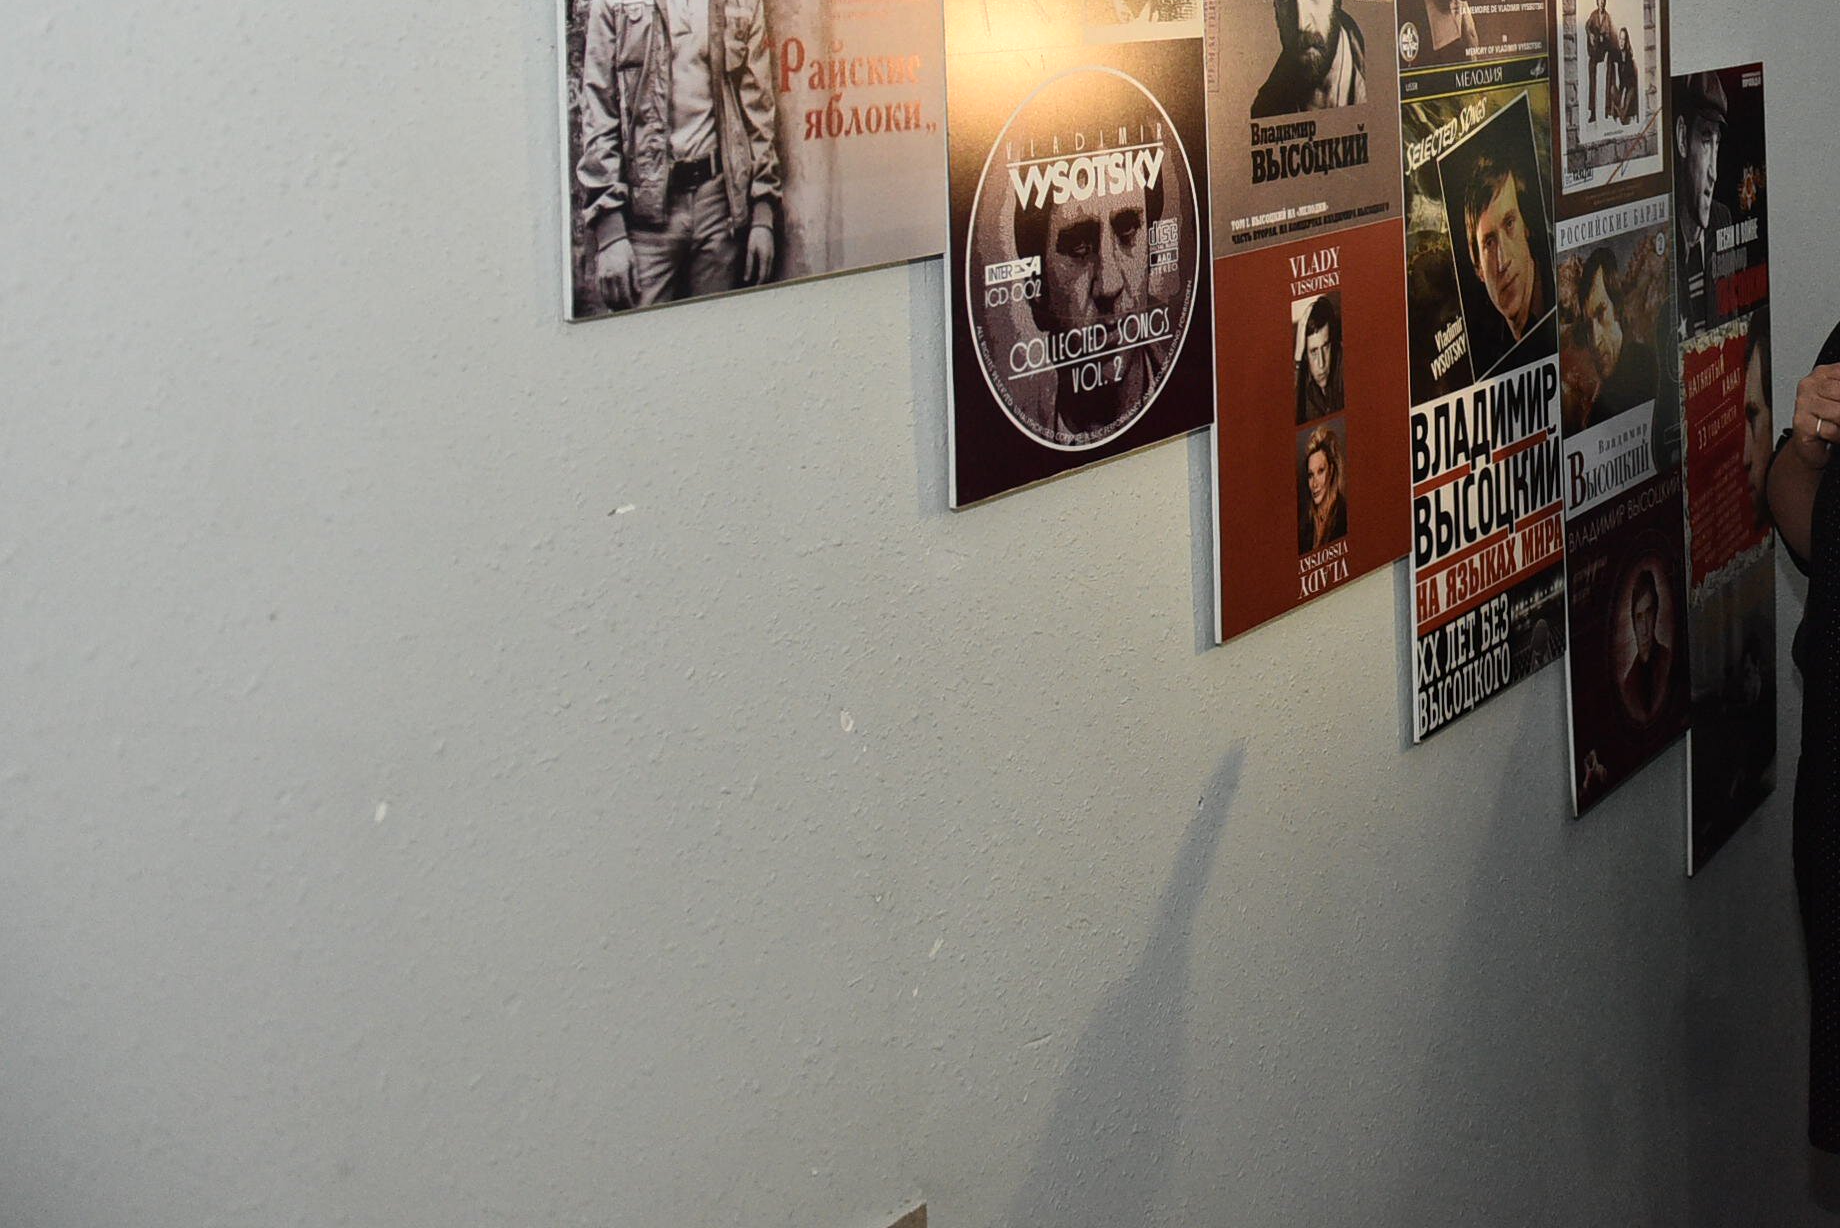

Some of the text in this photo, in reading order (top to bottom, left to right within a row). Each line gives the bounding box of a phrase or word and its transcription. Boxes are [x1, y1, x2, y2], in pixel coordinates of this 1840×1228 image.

[1455, 66, 1504, 89] МЕЛОДИЯ
[1006, 123, 1165, 161] VLADIMIR
[1251, 123, 1369, 185] ВЫСОЦКИЙ
[1406, 98, 1488, 176] SELECTED SONGS
[1009, 148, 1165, 211] VYSOTSKY
[1289, 246, 1341, 279] VLADY
[1290, 272, 1341, 297] VISSOTSKY
[1009, 307, 1171, 372] COLLECTED SONGS
[1430, 336, 1468, 381] VYSOTSKY
[1434, 315, 1463, 349] Vladimir
[1111, 356, 1123, 382] 2
[1412, 362, 1557, 485] ВЛАДИМИР
[1413, 425, 1562, 569] ВЫСОЦКИЙ
[1416, 577, 1441, 624] НА
[1445, 535, 1518, 610] ЯЗЫКАХ
[1521, 512, 1564, 568] МИРА
[1445, 610, 1477, 672] ЛЕТ
[1480, 592, 1511, 652] БЕЗ
[1418, 640, 1512, 739] ВЫСОЦКОГО
